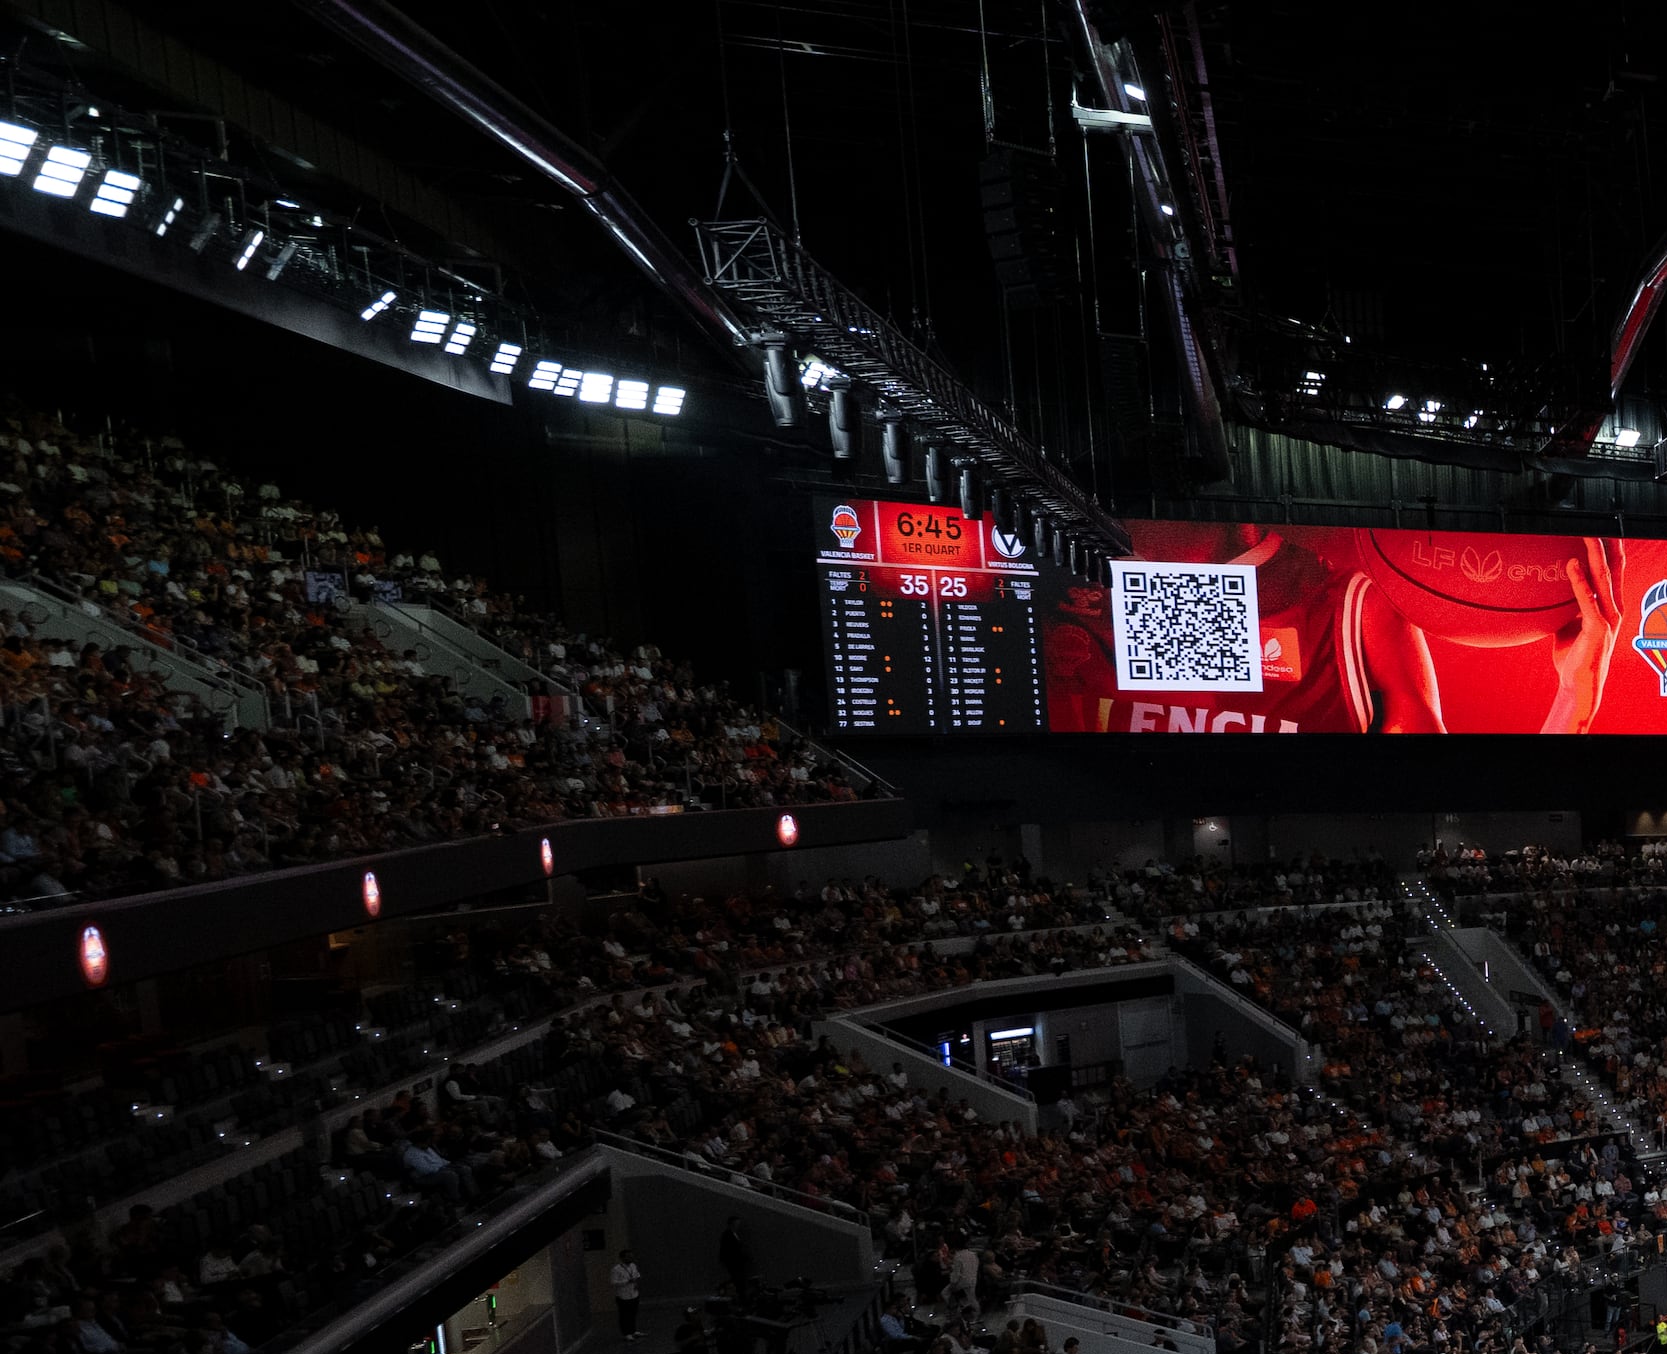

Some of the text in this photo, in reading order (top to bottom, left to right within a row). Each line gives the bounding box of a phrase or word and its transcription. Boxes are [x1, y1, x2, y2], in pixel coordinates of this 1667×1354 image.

[897, 512, 961, 540] 6:45
[820, 550, 874, 560] VALENCIA BASKET
[903, 543, 961, 555] 1ER QUART
[1413, 541, 1456, 570] LF
[900, 574, 929, 594] 35
[940, 577, 967, 597] 25
